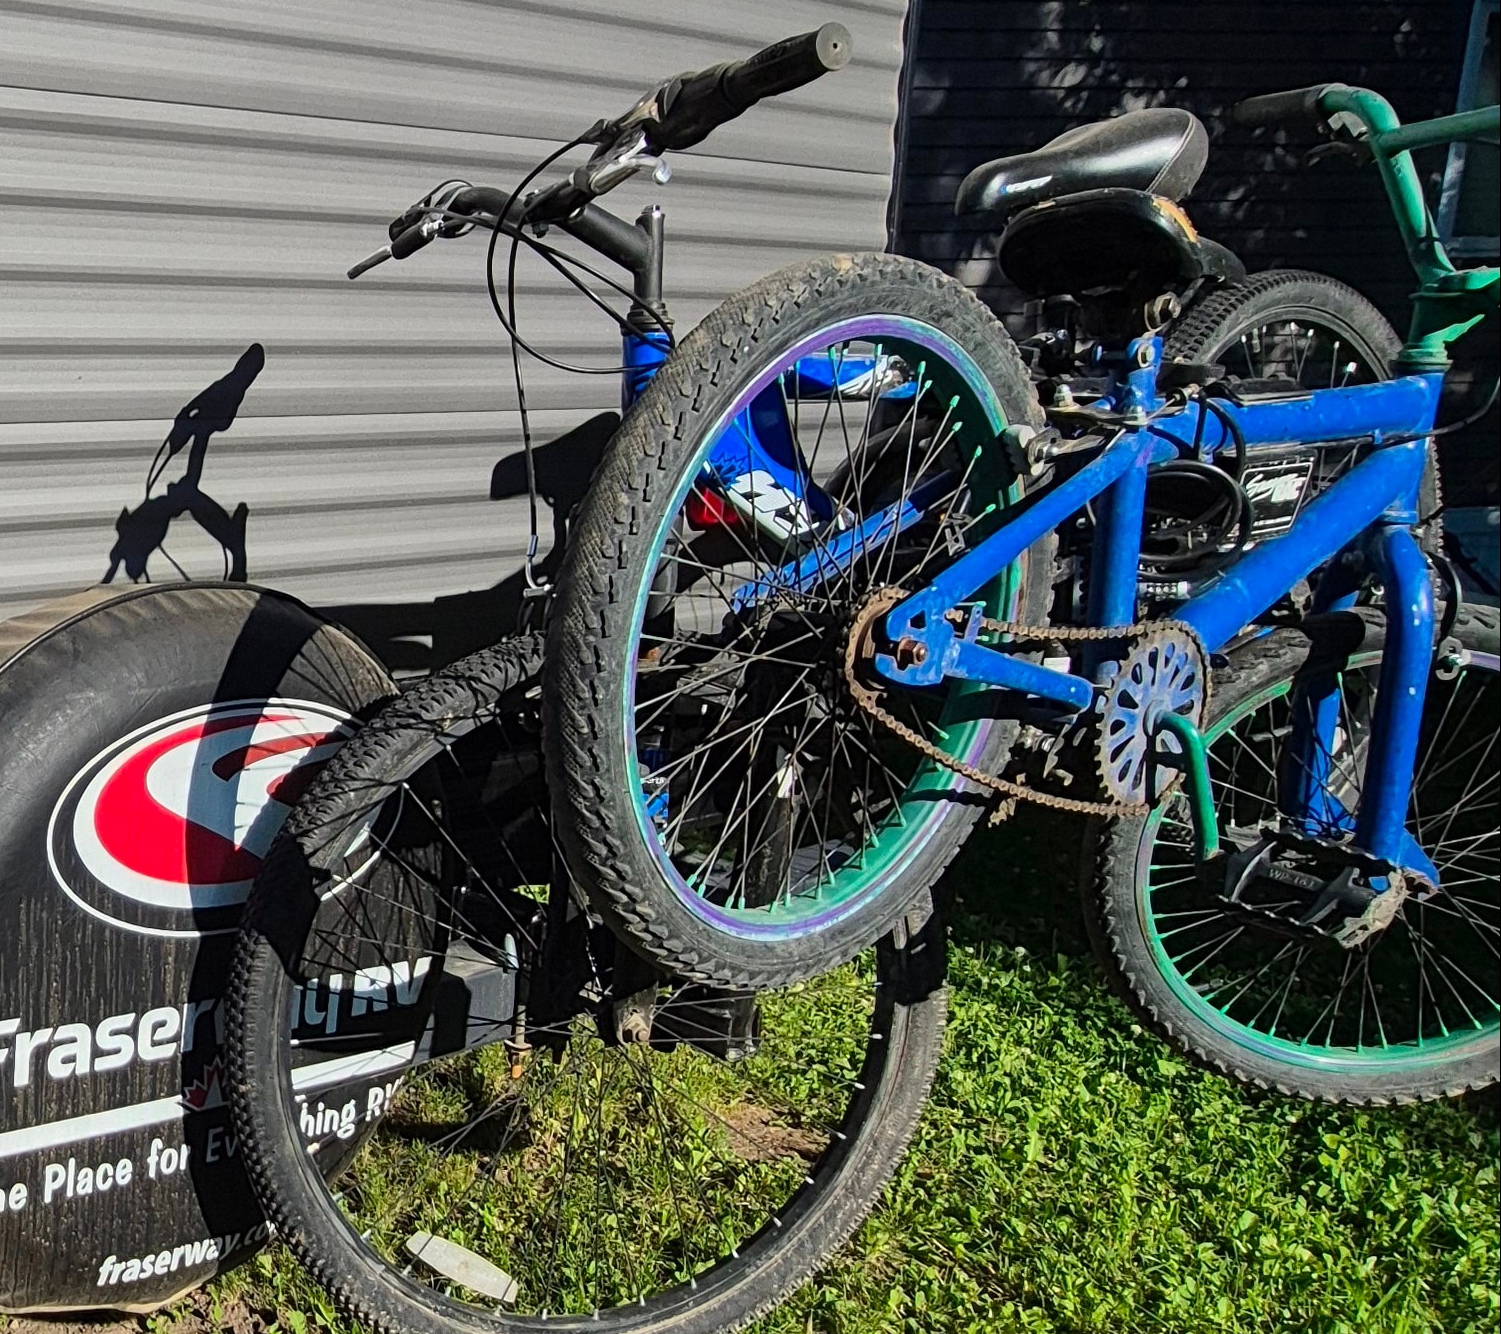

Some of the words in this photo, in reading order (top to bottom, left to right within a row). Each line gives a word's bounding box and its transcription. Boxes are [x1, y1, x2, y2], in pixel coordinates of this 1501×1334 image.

[351, 955, 433, 1017] RV
[45, 1159, 133, 1206] Place
[147, 1138, 190, 1179] for
[206, 1099, 356, 1163] Evhing
